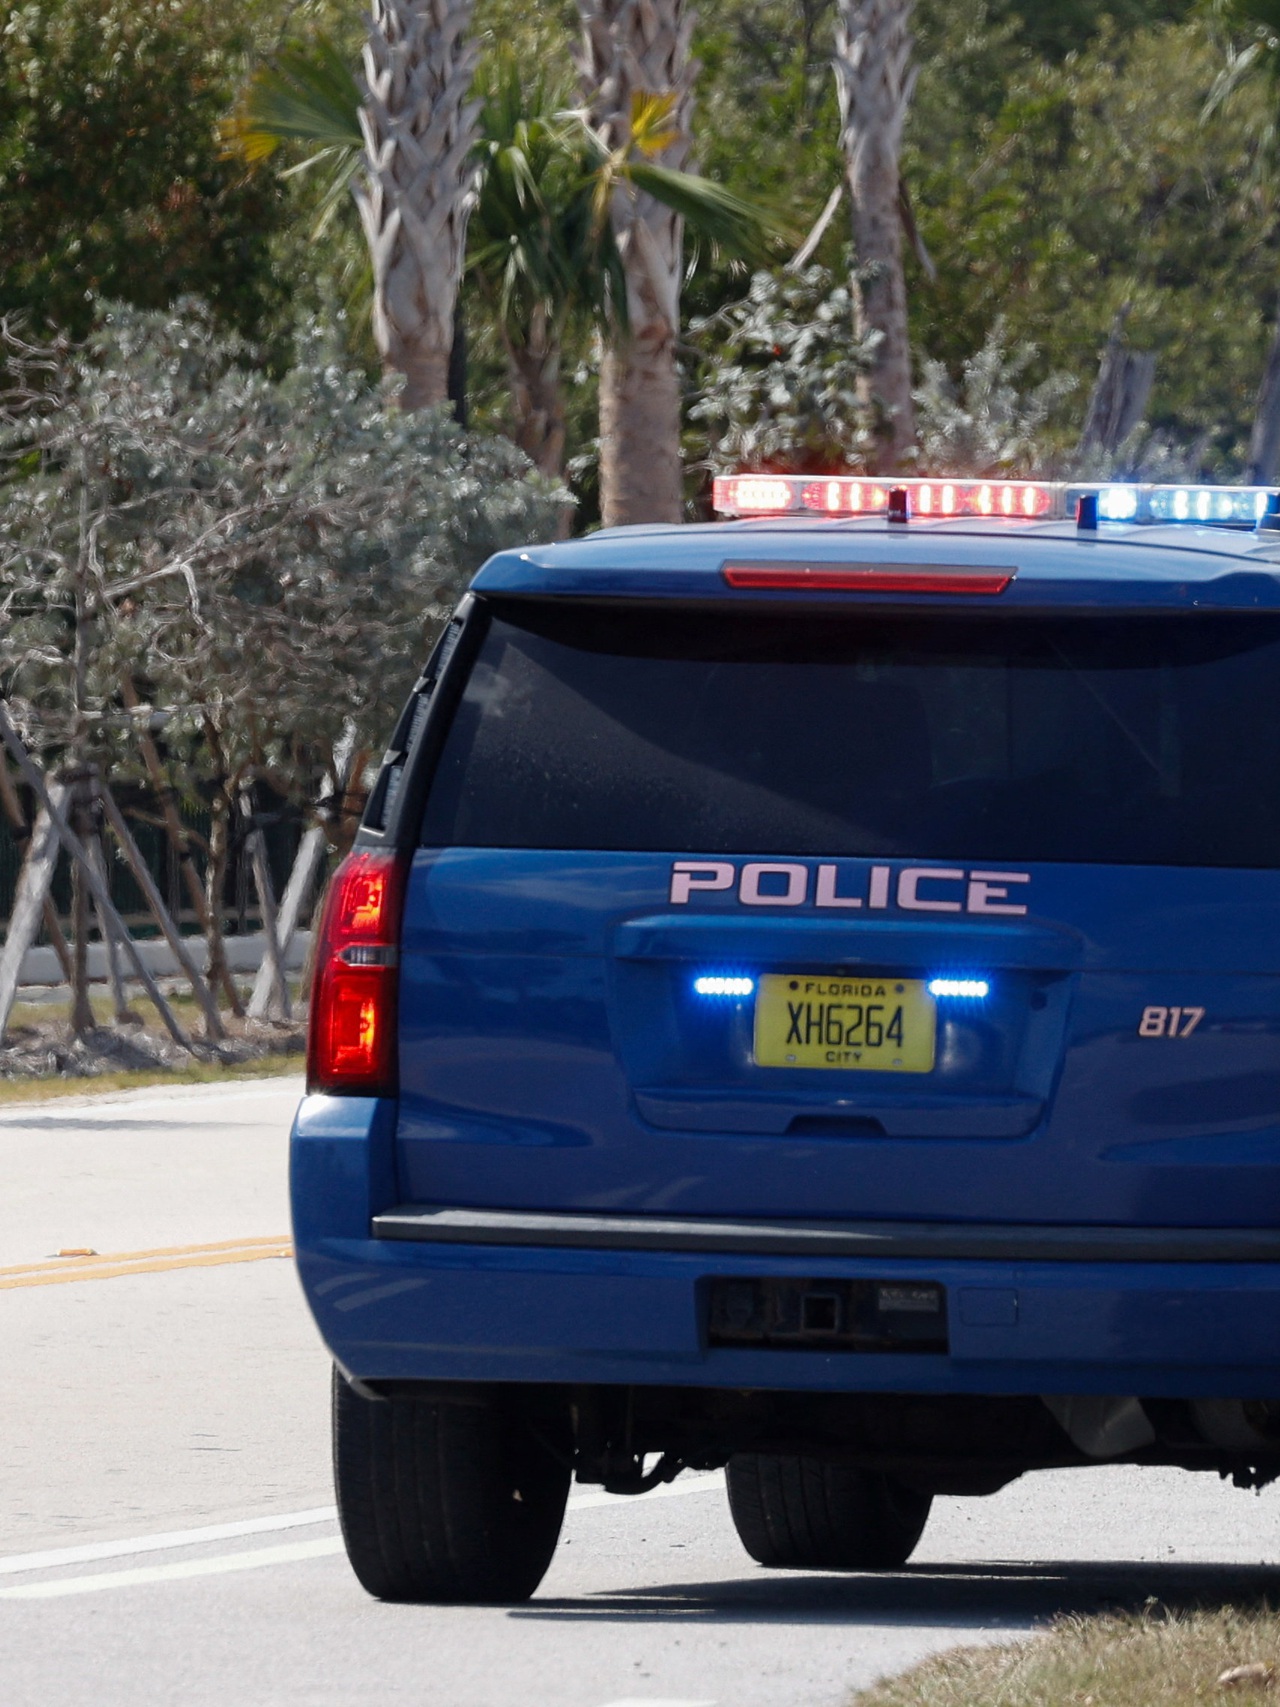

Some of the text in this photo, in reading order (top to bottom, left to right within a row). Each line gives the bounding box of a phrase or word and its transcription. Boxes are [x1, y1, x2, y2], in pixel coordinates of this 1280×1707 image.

[670, 861, 1031, 915] POLICE
[804, 982, 887, 997] FLORIDA
[786, 1001, 904, 1048] XH6264
[1138, 1005, 1206, 1038] 817
[825, 1051, 862, 1063] CITY
